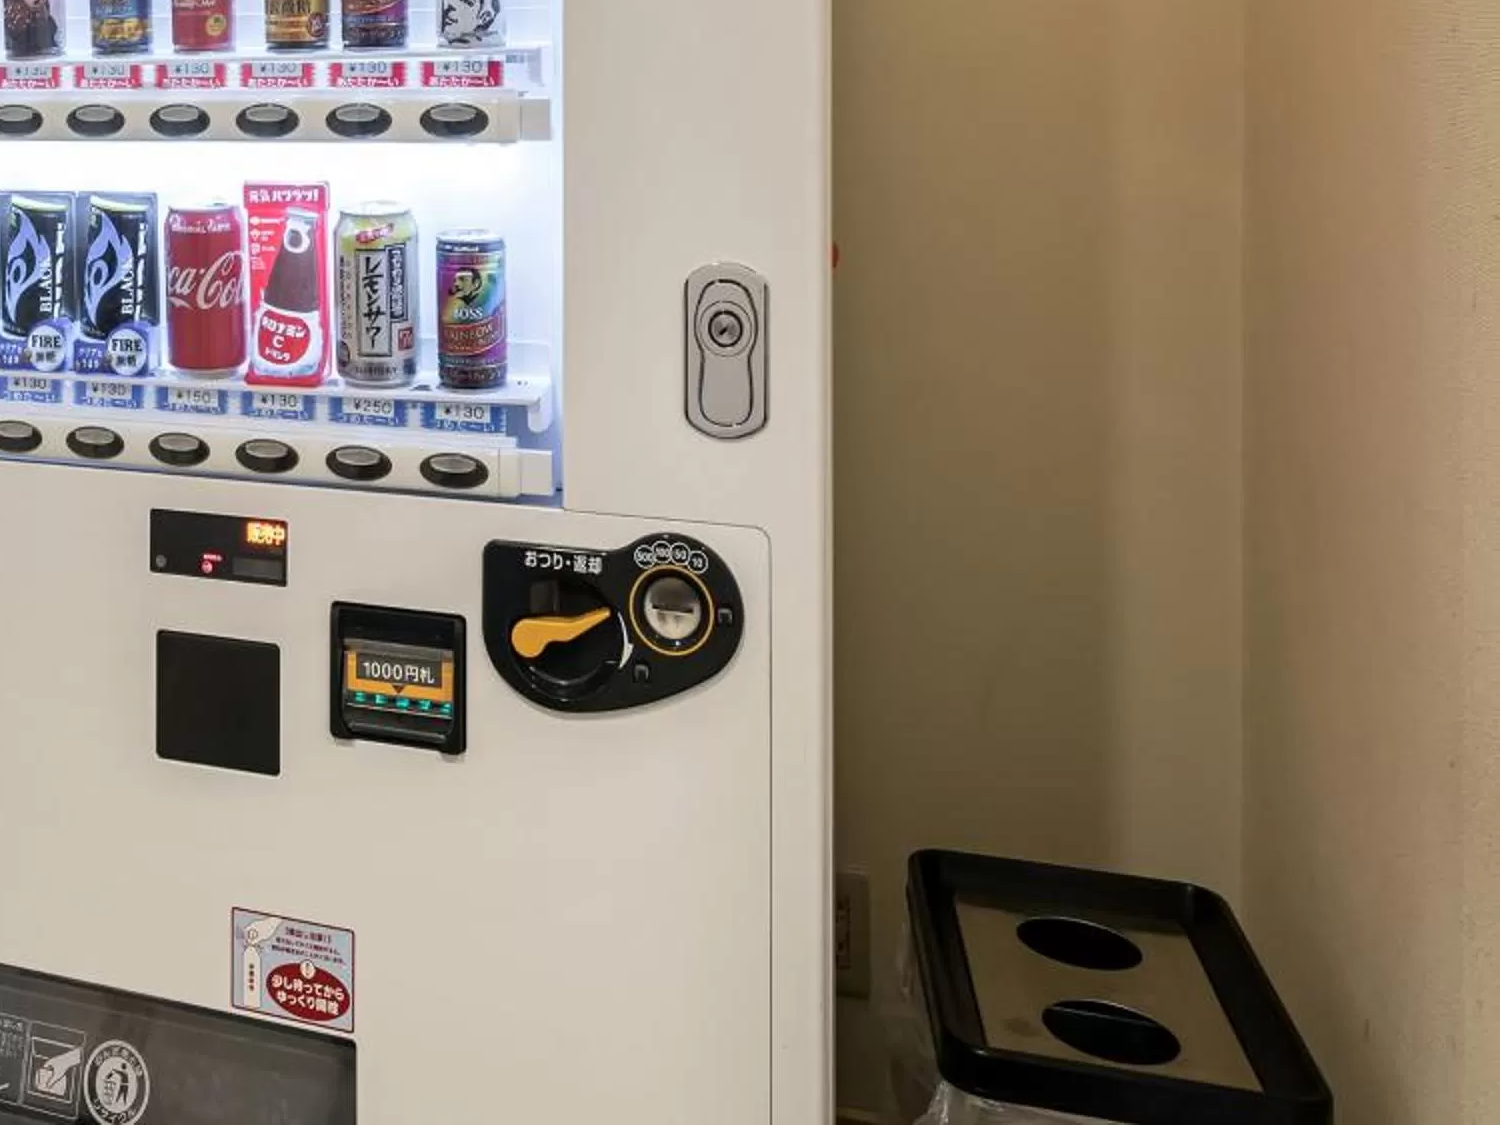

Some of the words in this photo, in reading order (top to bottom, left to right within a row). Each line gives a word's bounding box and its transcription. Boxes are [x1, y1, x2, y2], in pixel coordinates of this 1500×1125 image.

[442, 59, 484, 74] ¥130
[361, 256, 387, 350] レモンサワー
[31, 334, 61, 348] FIRE
[111, 338, 143, 352] FIRE
[272, 335, 285, 348] C
[12, 376, 47, 390] ¥130
[90, 382, 126, 396] ¥130
[175, 389, 212, 404] ¥150
[259, 394, 297, 408] ¥130
[352, 399, 393, 415] ¥250
[442, 406, 485, 421] ¥130
[523, 550, 602, 575] おつり・返却
[362, 660, 435, 684] 1000円札
